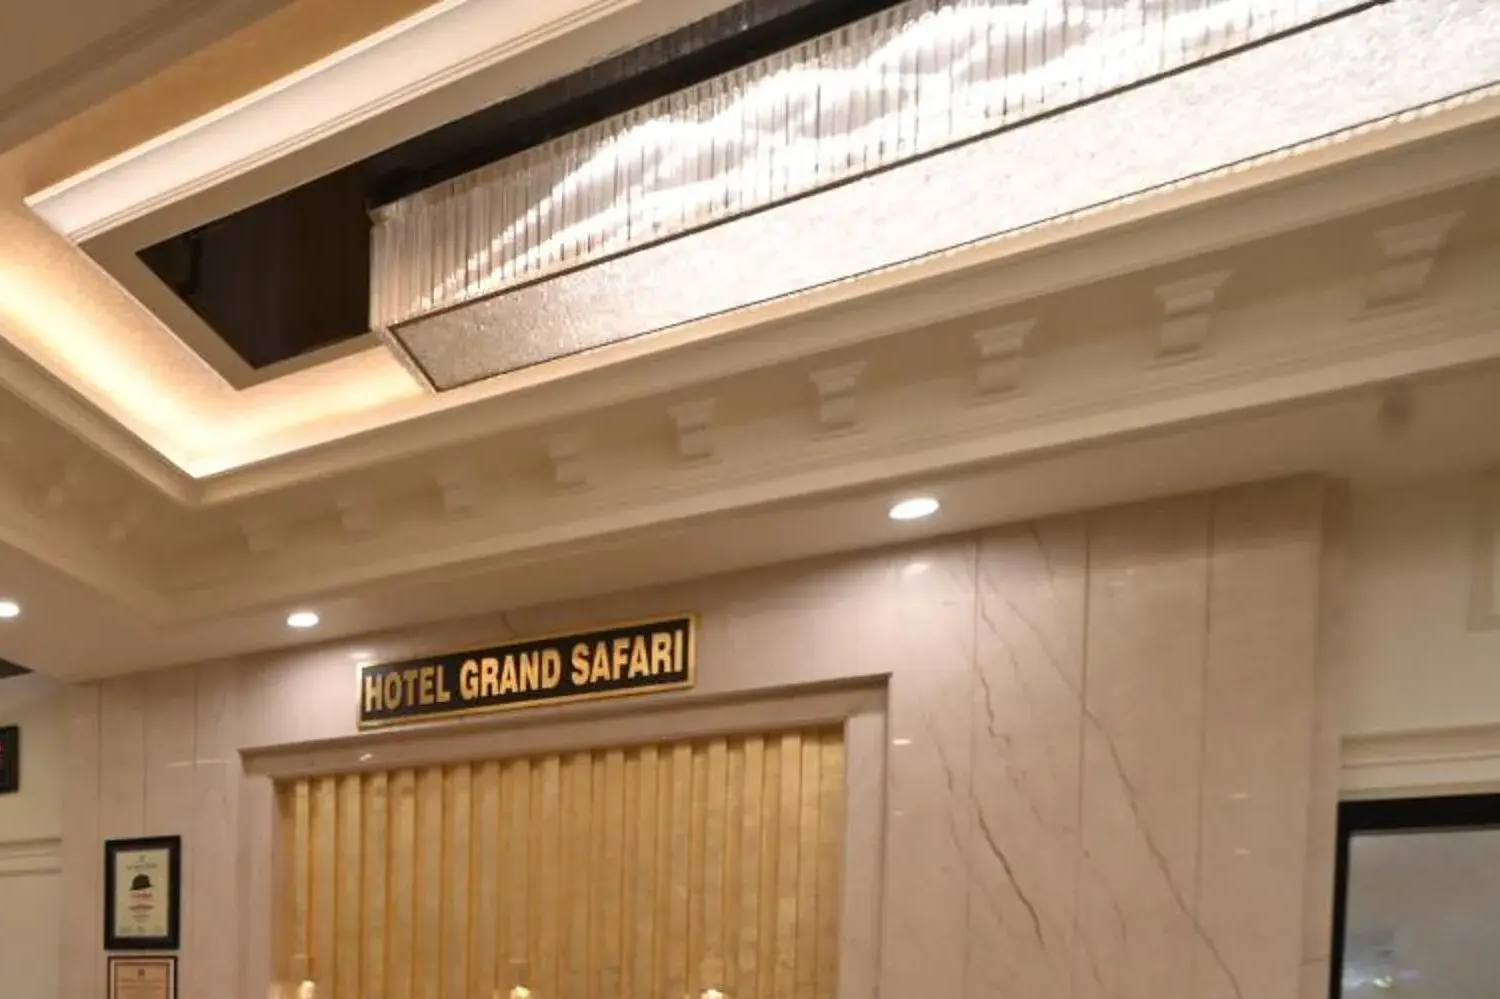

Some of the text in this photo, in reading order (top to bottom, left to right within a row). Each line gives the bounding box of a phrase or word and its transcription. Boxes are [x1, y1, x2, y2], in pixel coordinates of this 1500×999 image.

[365, 629, 683, 713] HOTEL GRAND SAFARI
